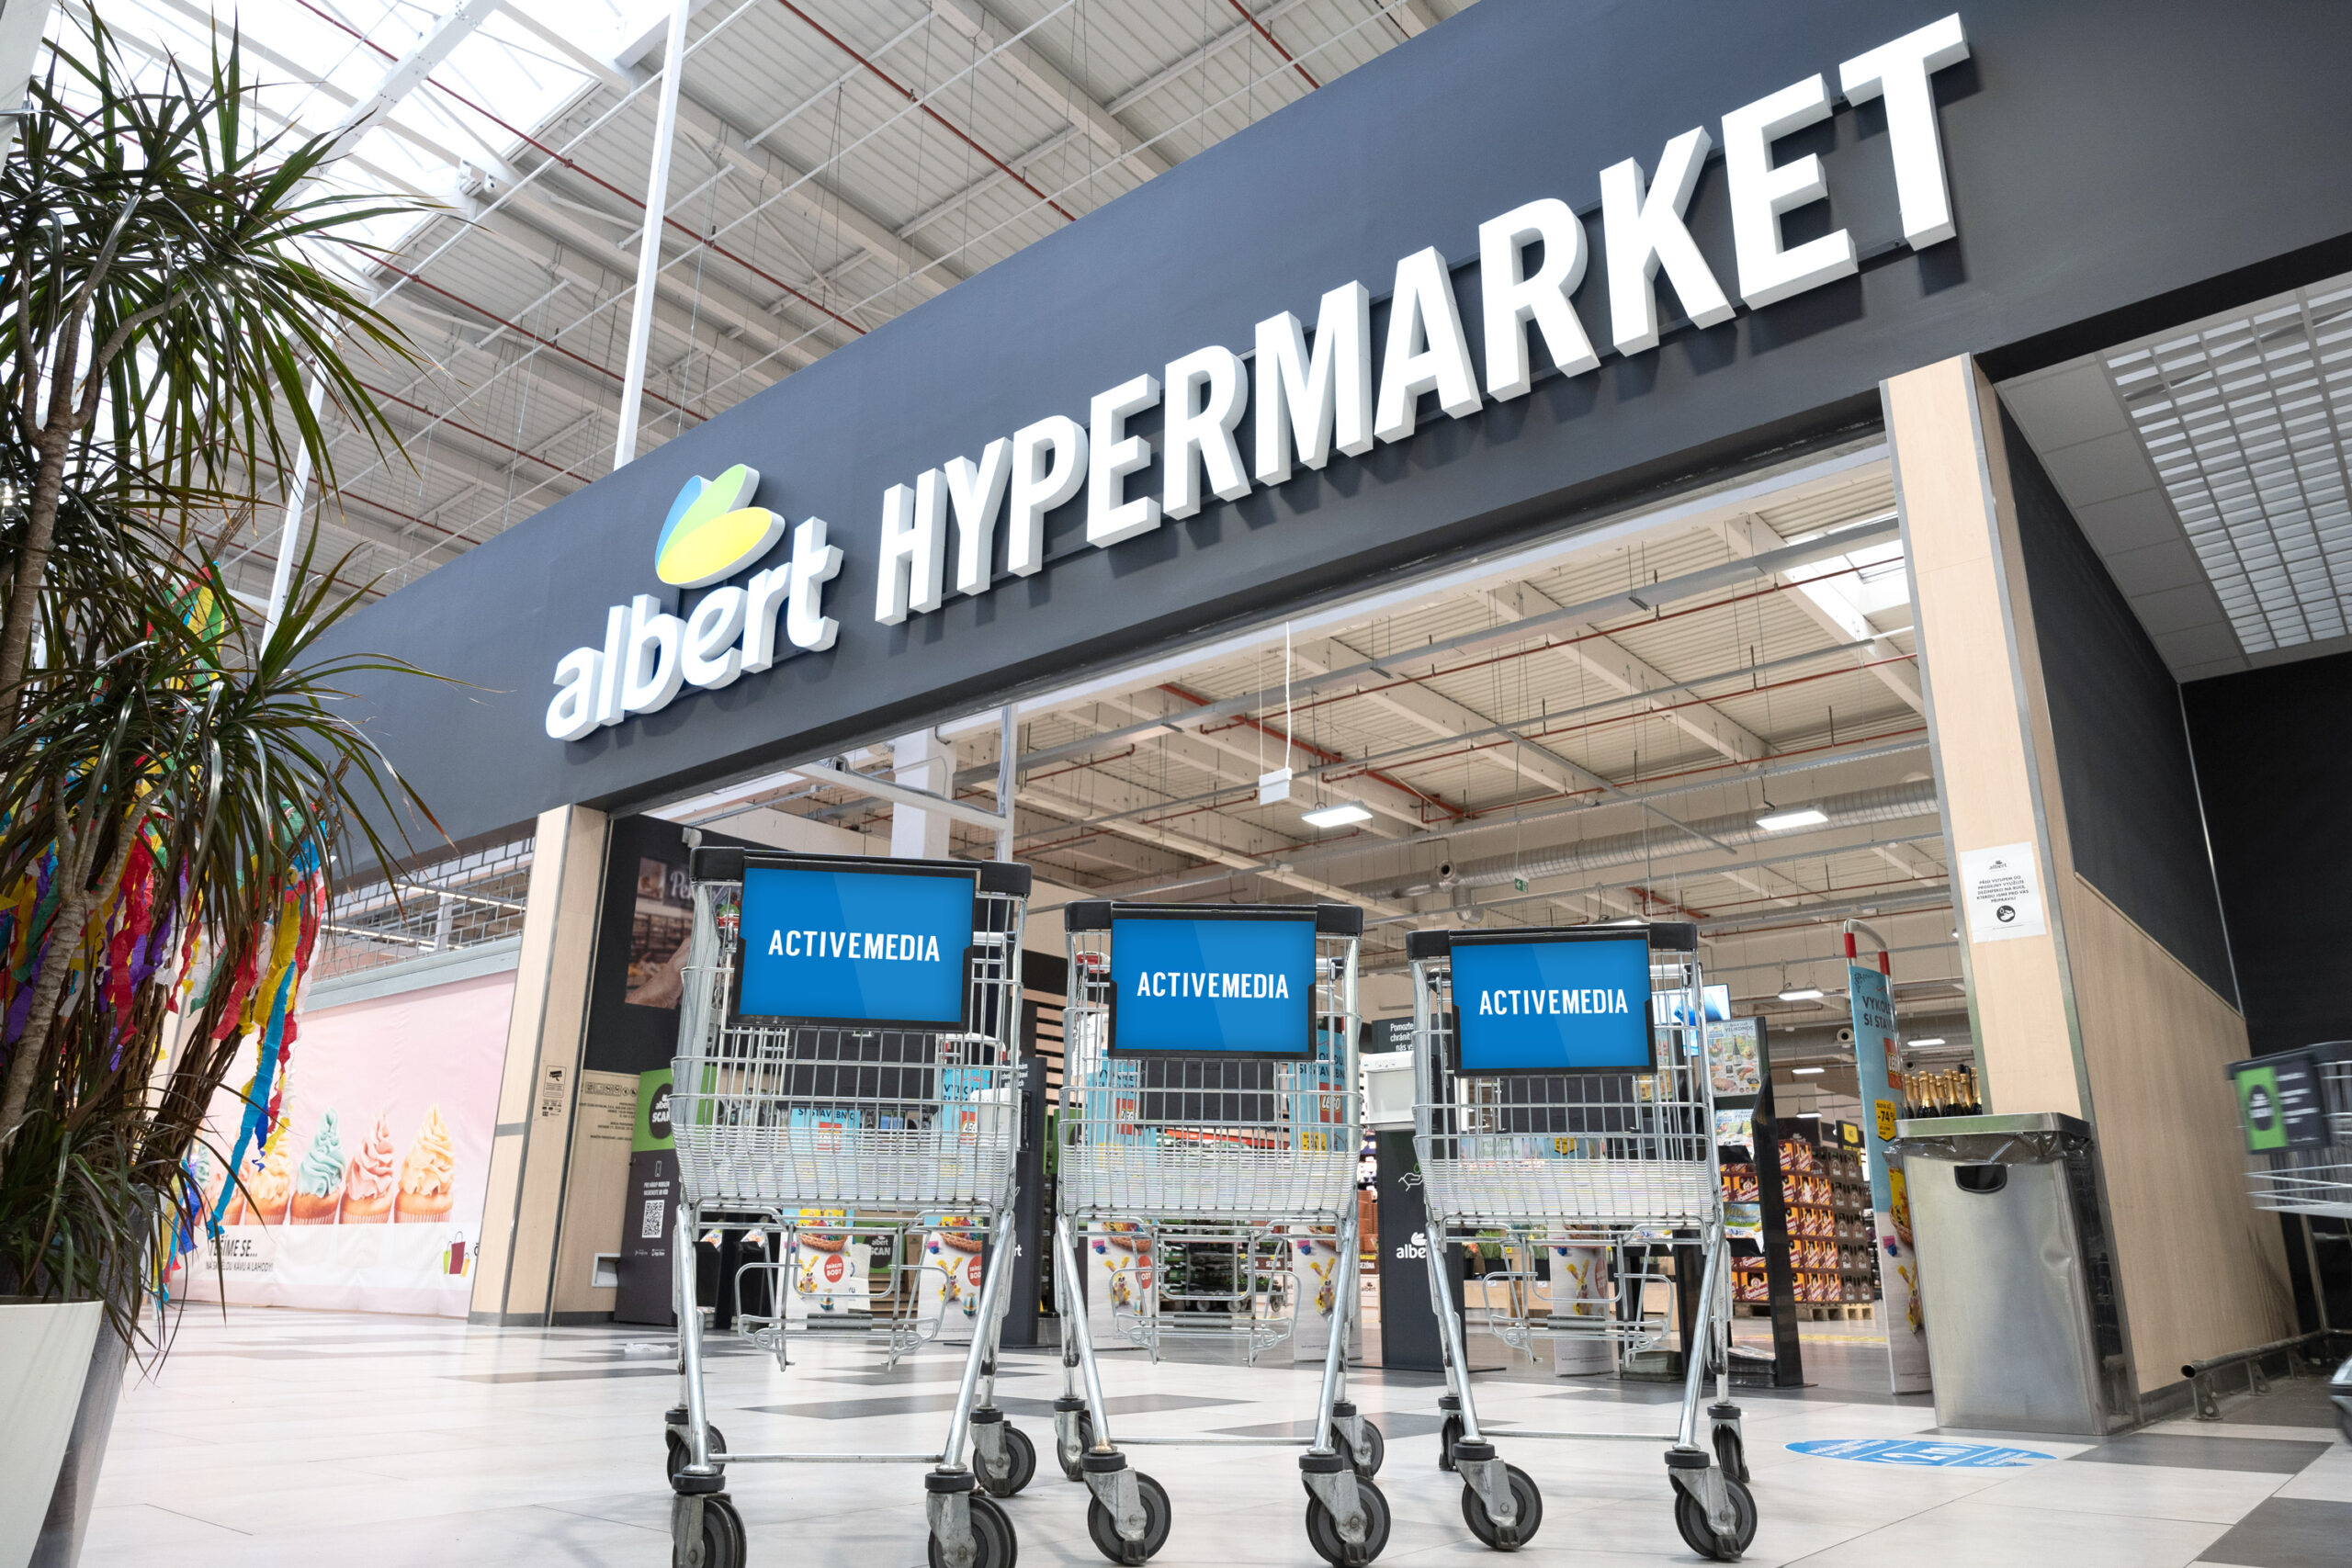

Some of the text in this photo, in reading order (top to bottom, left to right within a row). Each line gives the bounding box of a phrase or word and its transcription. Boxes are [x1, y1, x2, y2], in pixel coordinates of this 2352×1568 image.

[875, 12, 1971, 626] HYPERMARKET
[545, 516, 843, 742] albert
[768, 929, 941, 962] ACTIVEMEDIA
[1136, 971, 1289, 998] ACTIVEMEDIA
[1478, 988, 1629, 1016] ACTIVEMEDIA
[872, 1238, 888, 1247] albert
[1396, 1244, 1427, 1259] albe
